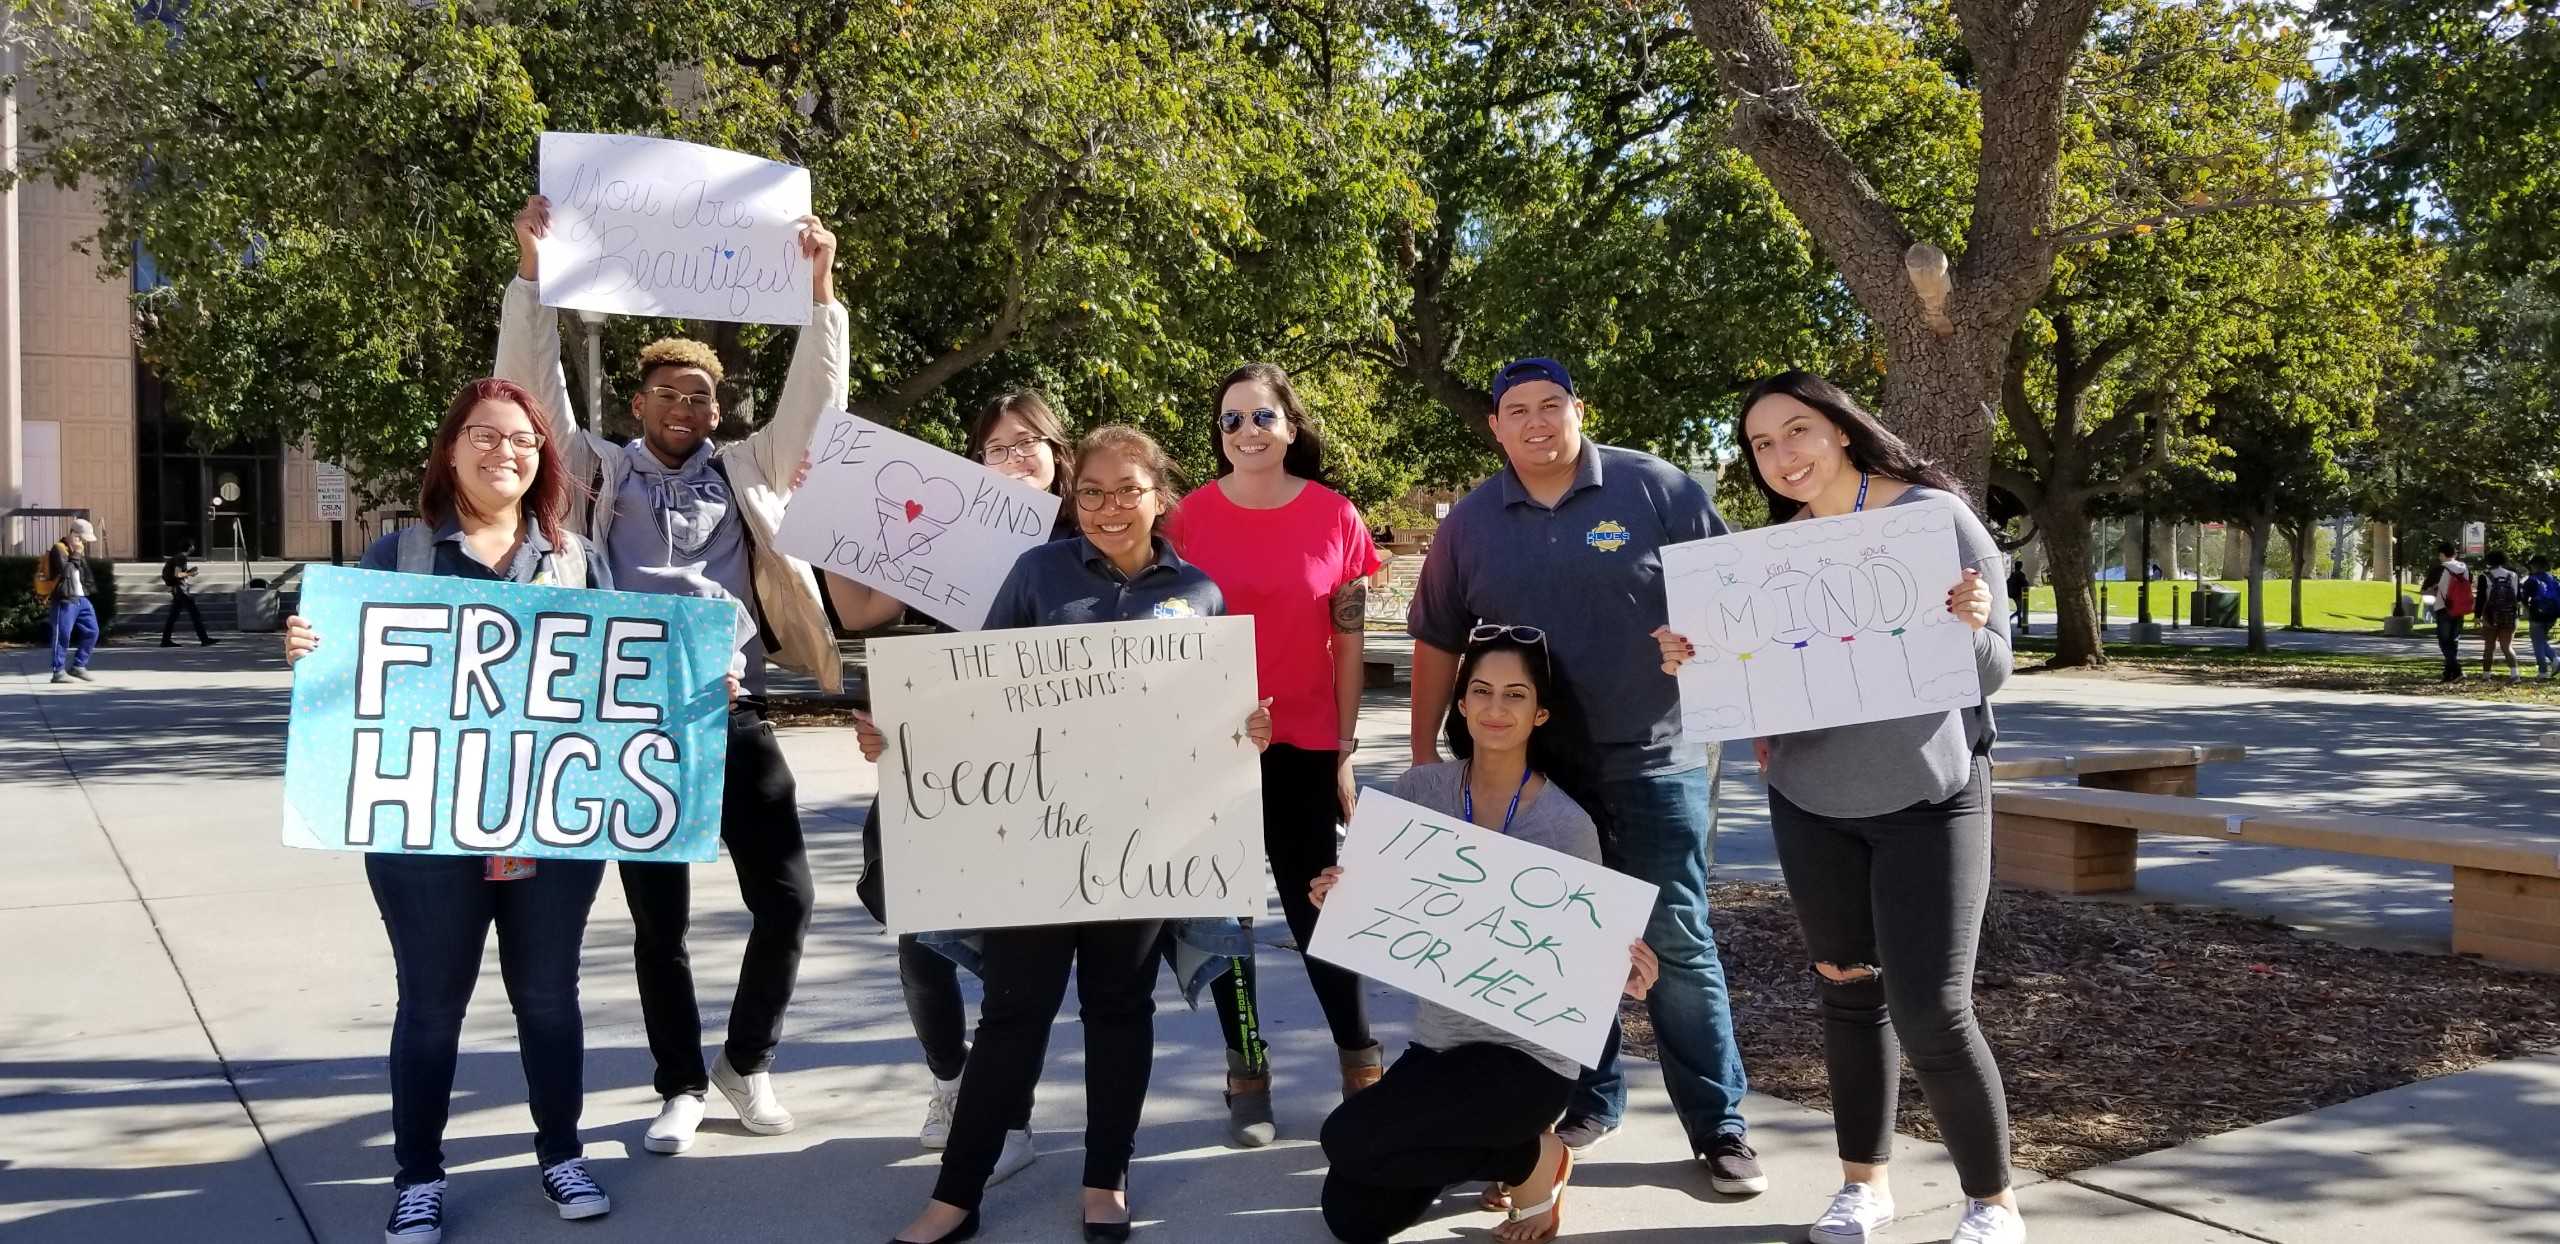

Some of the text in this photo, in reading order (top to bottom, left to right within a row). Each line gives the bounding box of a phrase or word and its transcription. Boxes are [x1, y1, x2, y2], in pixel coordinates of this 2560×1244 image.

[562, 162, 754, 241] You Are
[588, 223, 796, 317] Beautiful
[654, 477, 728, 510] NETS
[817, 420, 1042, 537] BE KIND
[823, 529, 971, 607] YOURSELF
[1586, 531, 1631, 545] BLUES
[1717, 569, 1738, 587] be
[1817, 556, 1832, 567] to
[1719, 562, 1908, 641] MIND
[354, 602, 670, 724] FREE
[943, 631, 1208, 681] THE BLUES PROJECT
[1002, 673, 1126, 713] PRESENTS:
[344, 728, 682, 852] HUGS
[899, 721, 1058, 825] beat
[1029, 801, 1093, 842] the
[1059, 827, 1248, 910] blues
[1378, 818, 1602, 929] IT'S OK
[1347, 907, 1587, 1028] FOR HELP
[1399, 877, 1564, 978] TO ASK
